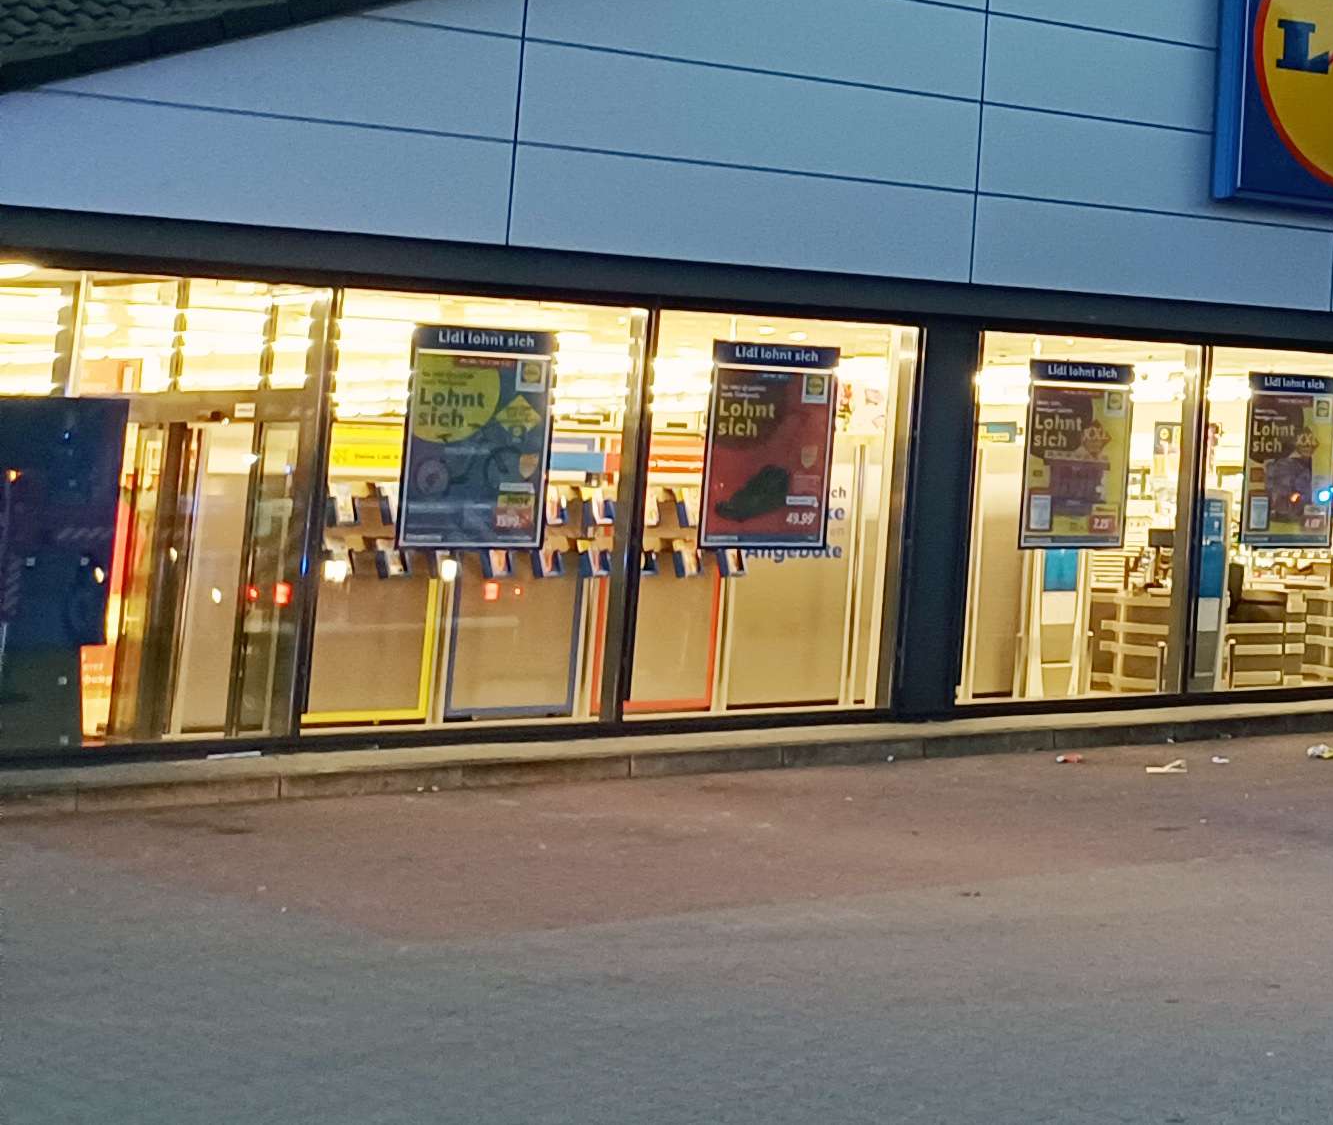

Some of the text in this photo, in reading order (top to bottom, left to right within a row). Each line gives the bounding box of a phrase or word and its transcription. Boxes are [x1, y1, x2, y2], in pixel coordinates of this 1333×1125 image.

[438, 330, 535, 348] Lidl lohnt sich
[735, 345, 819, 362] Lidl lohnt sich
[1047, 364, 1118, 379] Lidl lohnt sich
[1264, 377, 1326, 390] Lidl lohnt sich
[420, 387, 485, 409] Lohnt
[418, 406, 465, 428] sich
[719, 398, 776, 419] Lohnt
[718, 417, 758, 437] sich
[1035, 413, 1082, 432] Lohnt
[1253, 420, 1296, 437] Lohnt
[1034, 430, 1067, 447] sich
[1252, 436, 1283, 453] sich
